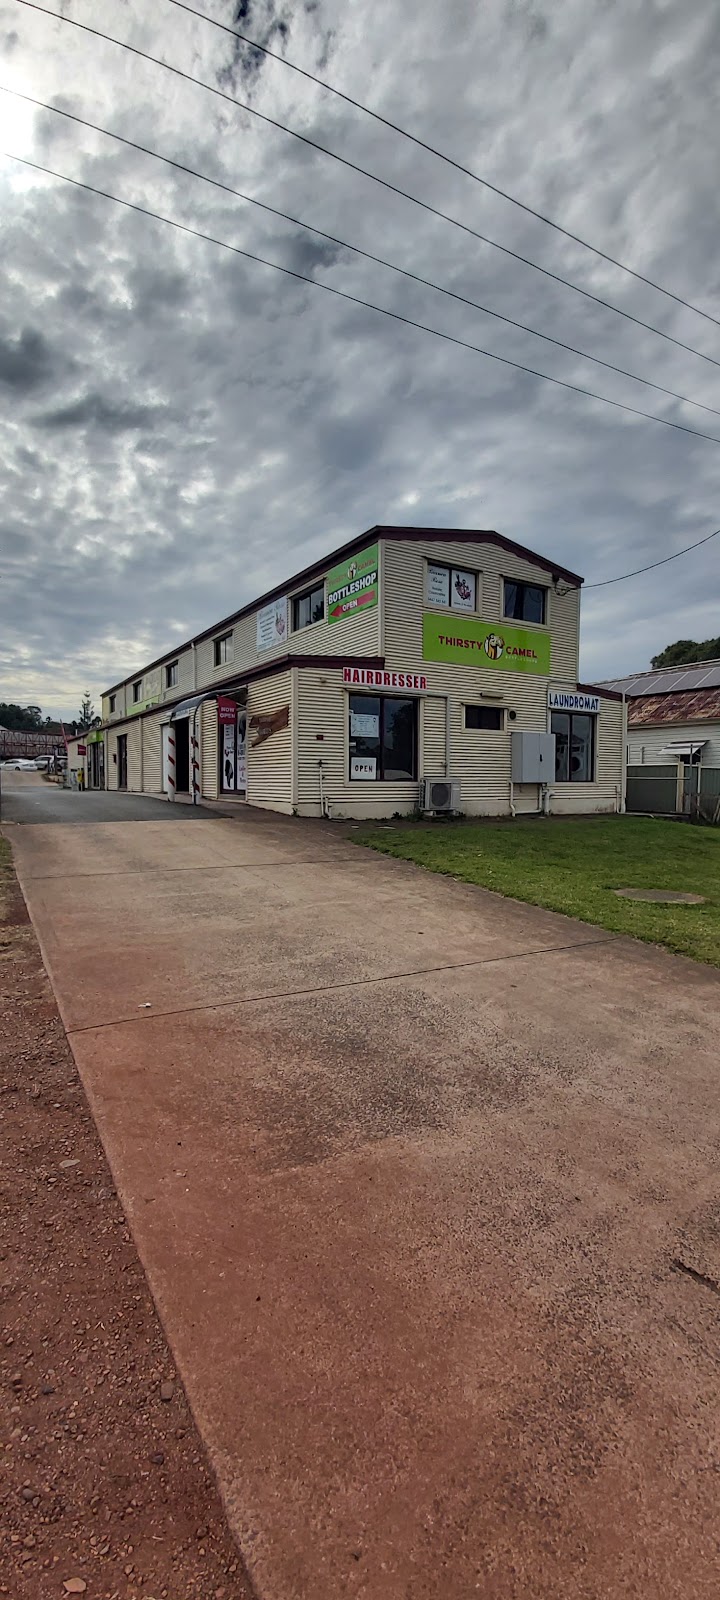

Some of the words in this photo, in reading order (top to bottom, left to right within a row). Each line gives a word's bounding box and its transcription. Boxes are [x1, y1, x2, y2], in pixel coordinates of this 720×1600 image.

[328, 572, 377, 604] BOTTLESHOP
[342, 599, 358, 612] OPEN
[438, 635, 483, 650] THIRSTY
[505, 646, 538, 659] CAMEL
[343, 668, 427, 690] HAIRDRESSER
[549, 692, 600, 711] LAUNDROMAT
[354, 764, 373, 773] OPEN
